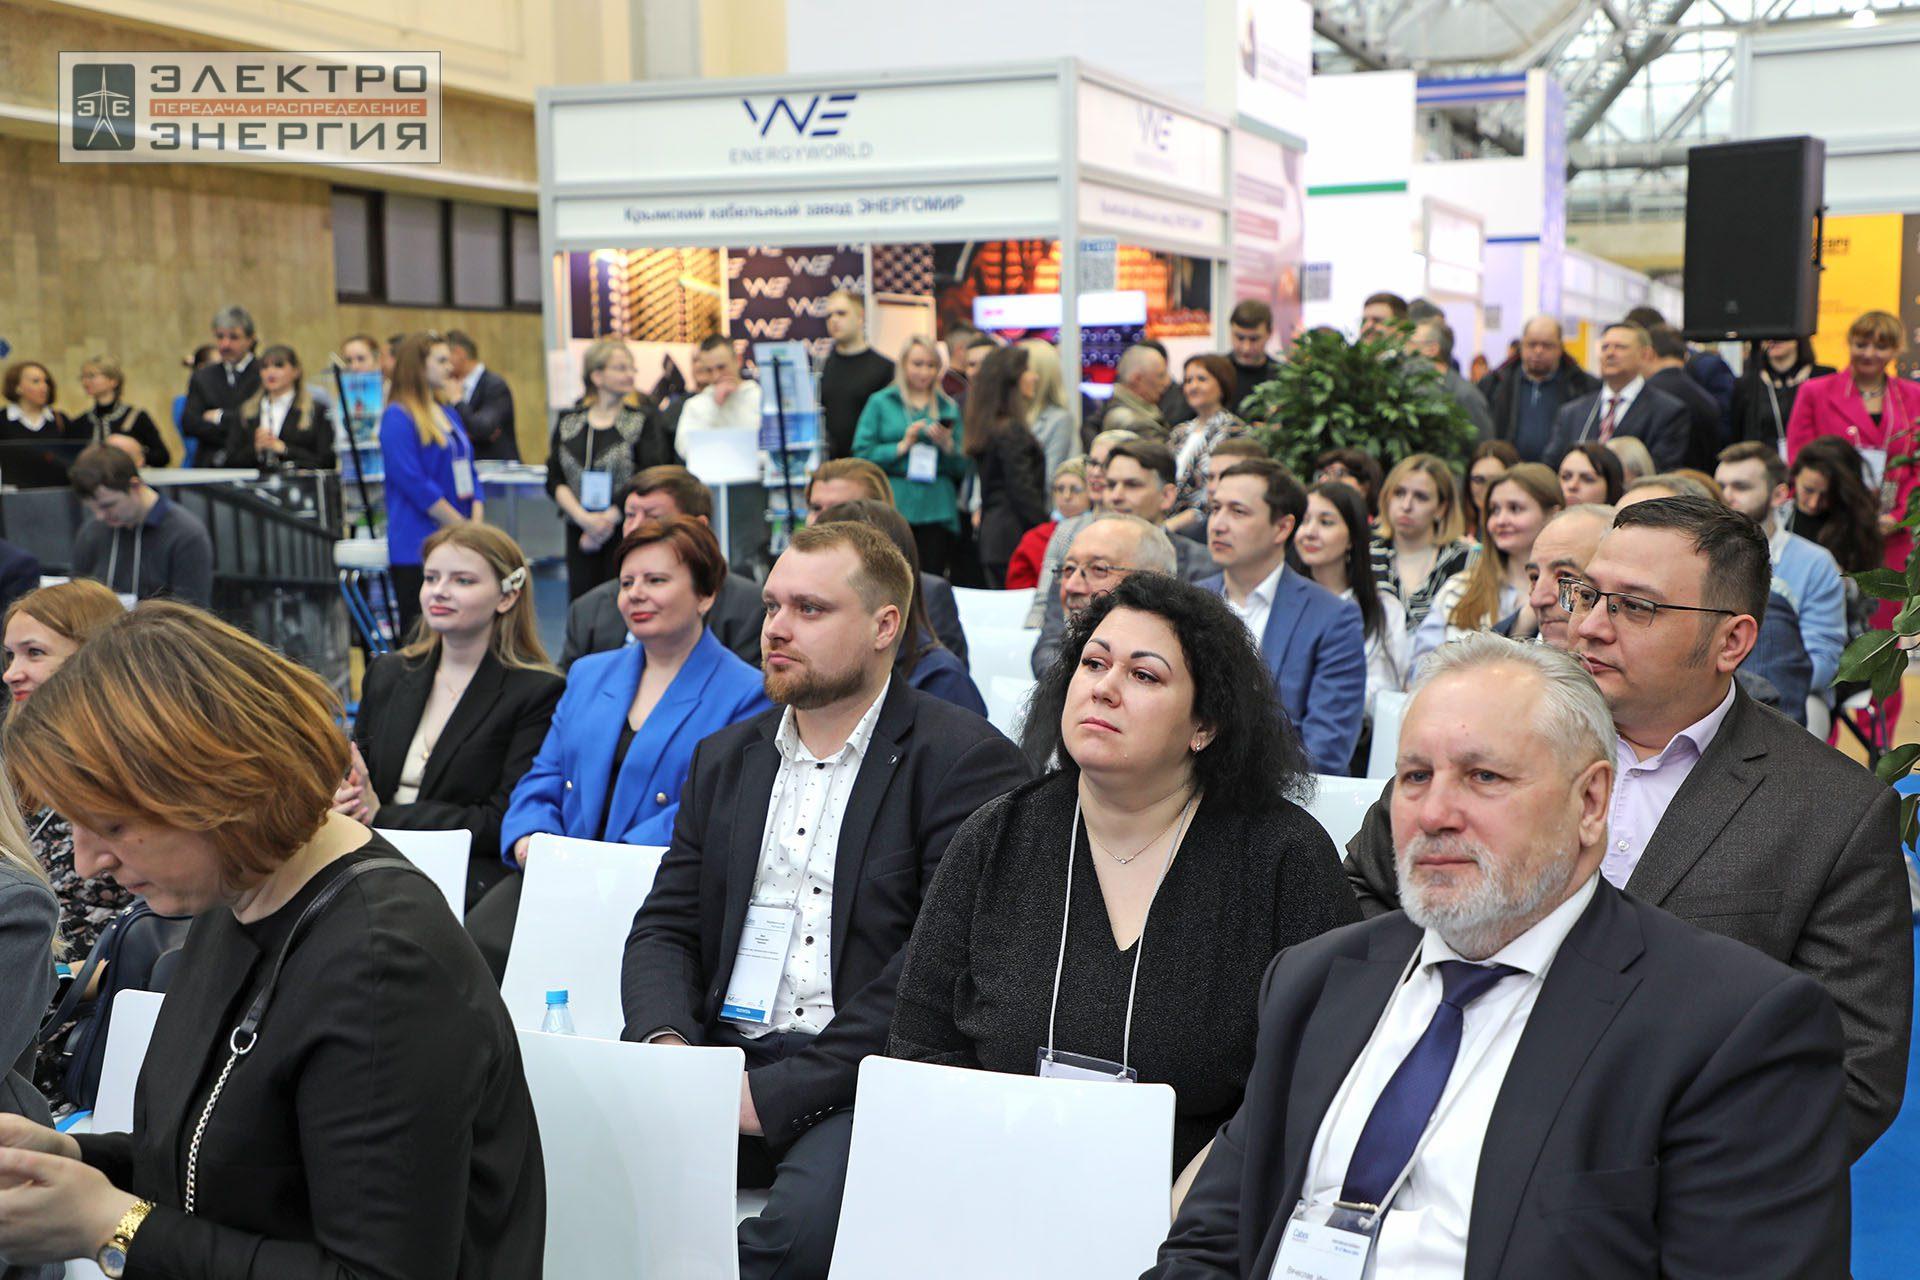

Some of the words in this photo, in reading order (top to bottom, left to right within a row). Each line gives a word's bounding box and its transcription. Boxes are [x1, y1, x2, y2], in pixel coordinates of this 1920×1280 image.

[729, 142, 873, 164] ENERGYWORLD
[624, 204, 704, 224] Крымский
[709, 199, 800, 218] кабельный
[807, 202, 853, 217] завод
[857, 194, 965, 215] ЭНЕРГОМИР
[786, 254, 834, 276] WE
[742, 276, 791, 299] WE
[744, 317, 792, 339] WE
